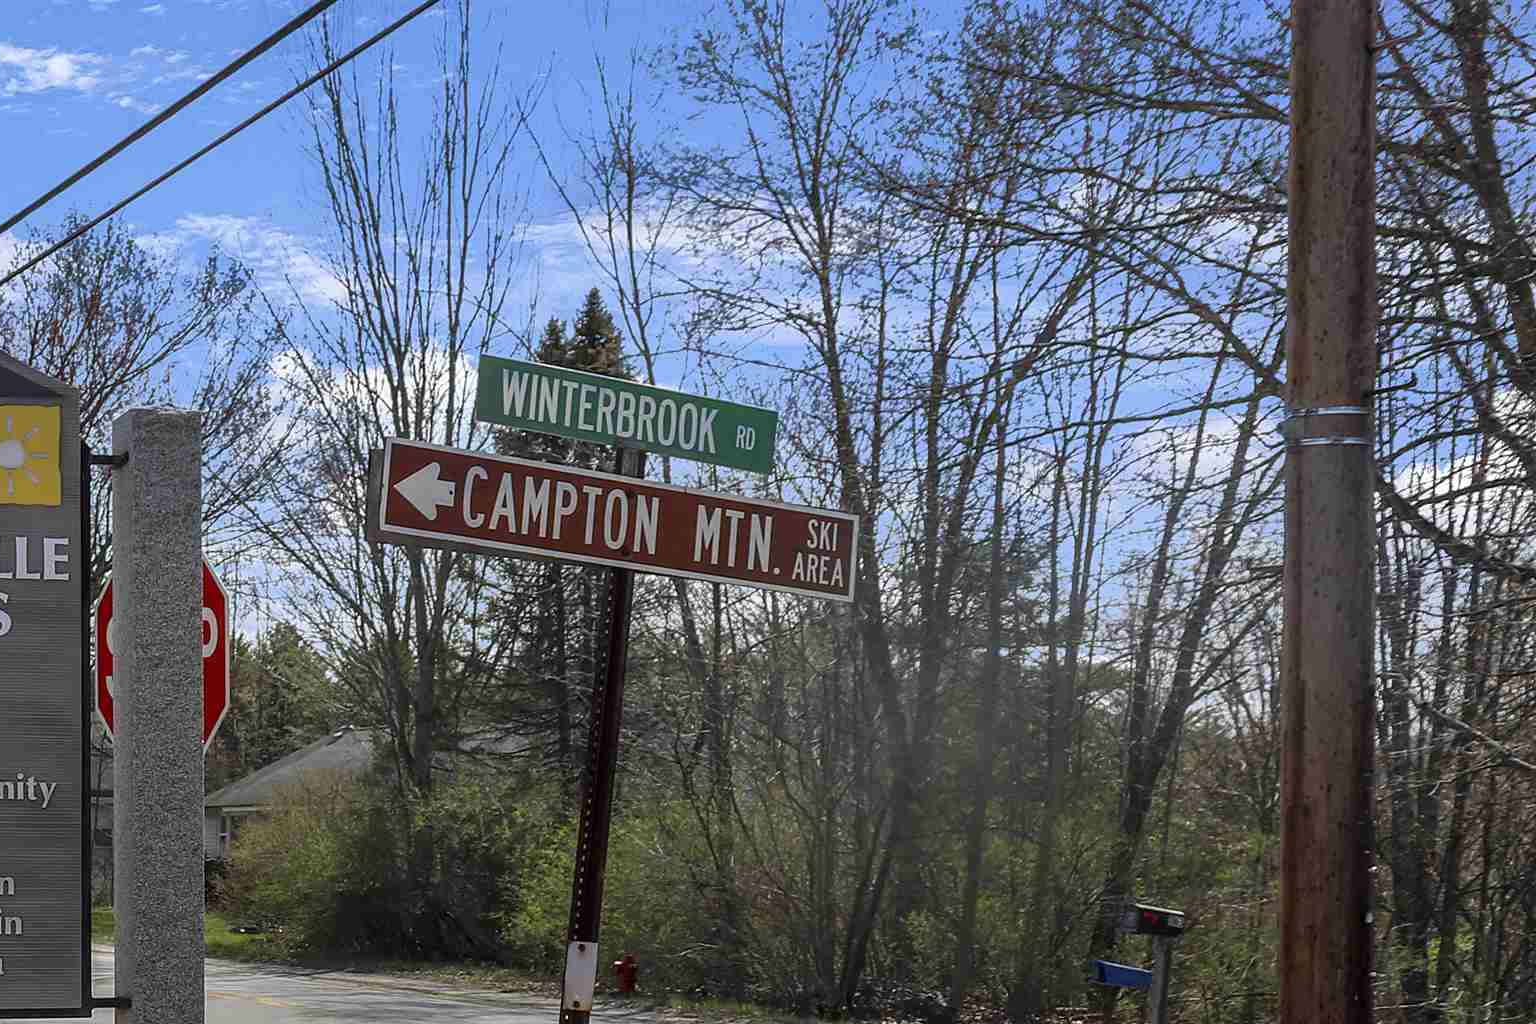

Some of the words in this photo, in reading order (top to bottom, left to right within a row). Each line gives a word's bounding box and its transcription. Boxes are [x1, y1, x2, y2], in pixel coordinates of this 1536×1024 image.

[502, 367, 719, 452] WINTERBROOK
[736, 425, 754, 449] RD
[463, 464, 659, 553] CAMPTON
[693, 504, 780, 574] MTN.
[807, 519, 838, 552] SKI
[791, 552, 843, 586] AREA
